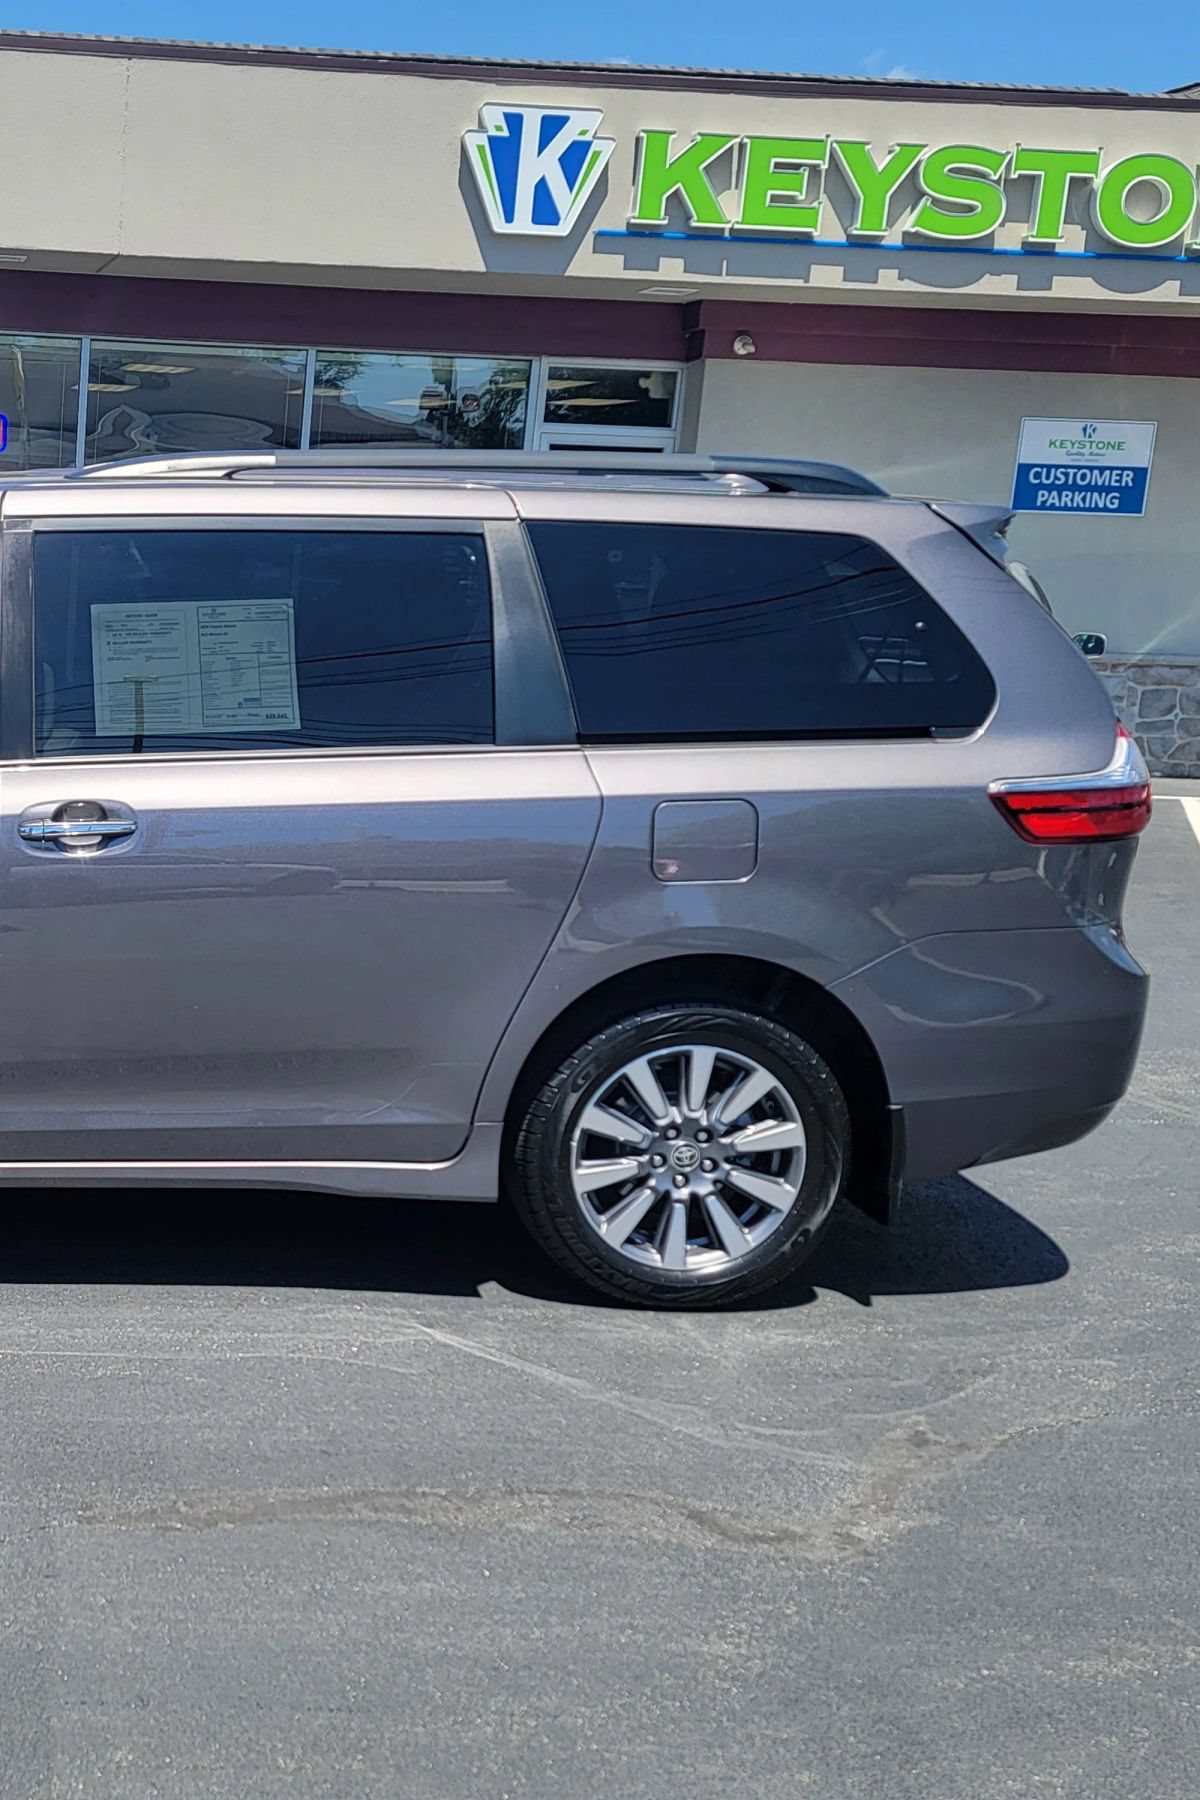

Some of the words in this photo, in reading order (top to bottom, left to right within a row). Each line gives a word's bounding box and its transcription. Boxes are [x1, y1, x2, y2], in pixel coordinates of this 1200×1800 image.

[627, 127, 1200, 249] KEYSTO
[1048, 438, 1127, 451] KEYSTONE
[1028, 467, 1135, 488] CUSTOMER
[1036, 490, 1121, 509] PARKING
